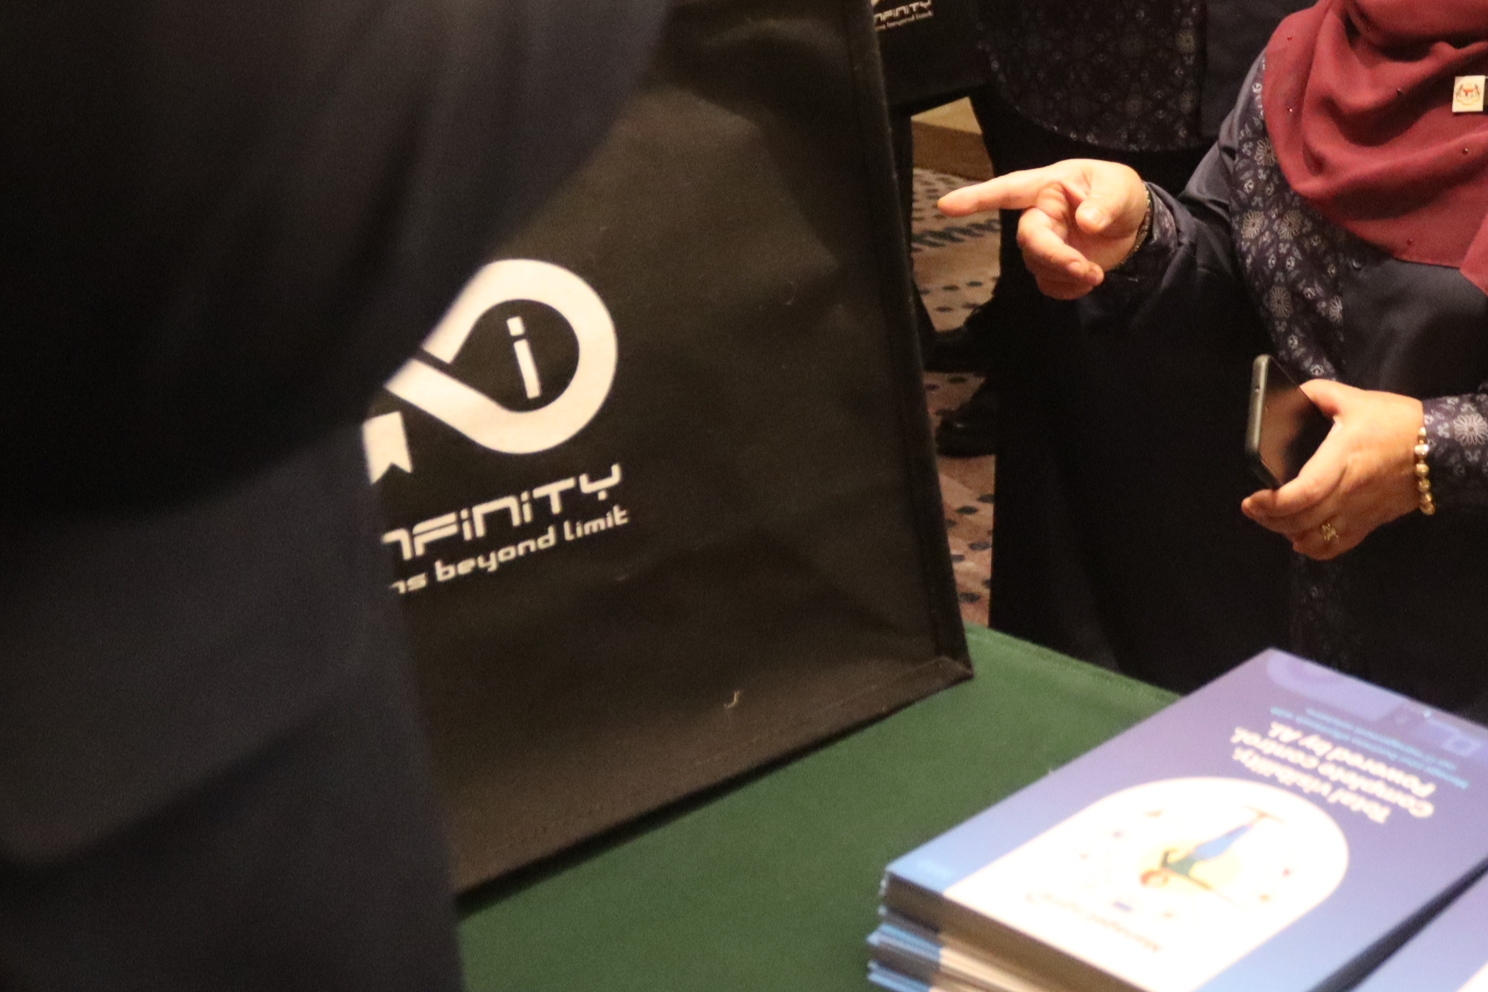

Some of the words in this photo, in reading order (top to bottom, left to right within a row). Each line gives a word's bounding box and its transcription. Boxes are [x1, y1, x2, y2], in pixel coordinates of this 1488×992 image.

[434, 525, 557, 583] beyond
[562, 504, 630, 541] limit
[1297, 734, 1334, 757] by
[1317, 762, 1434, 818] Complete
[1326, 746, 1436, 798] Powered
[1326, 788, 1391, 824] Total
